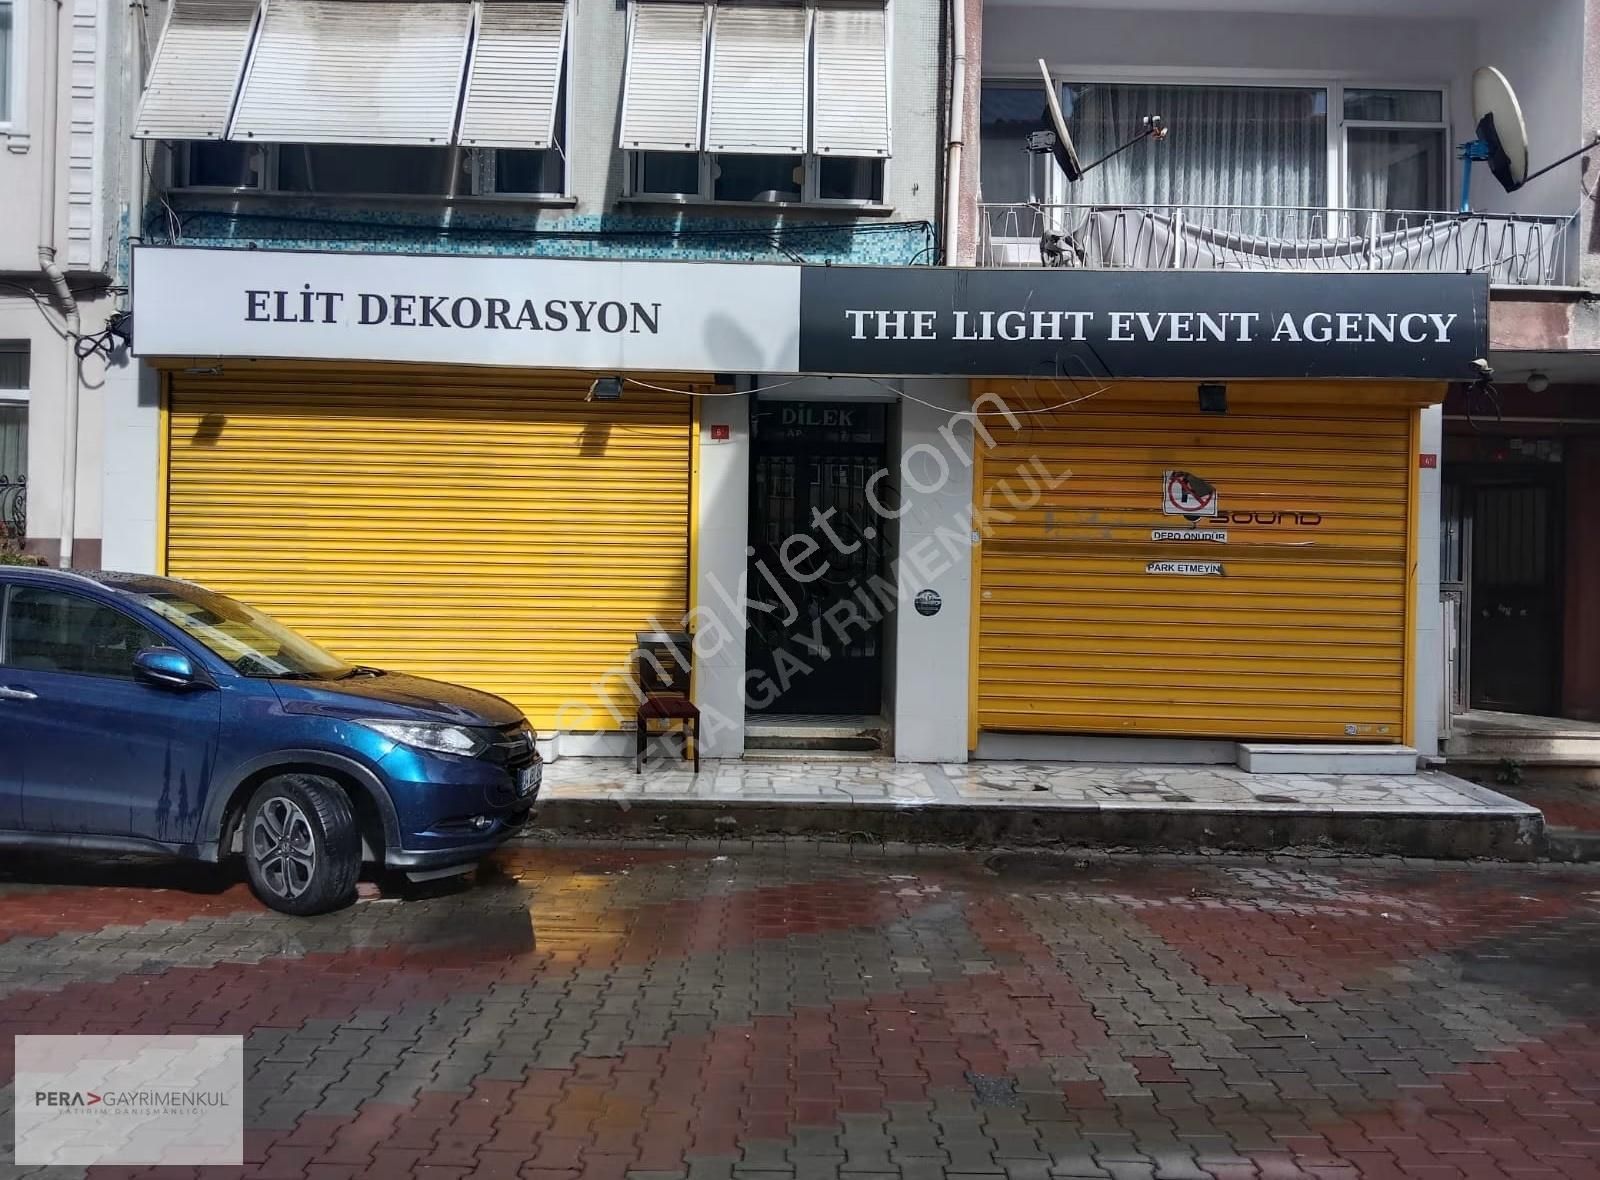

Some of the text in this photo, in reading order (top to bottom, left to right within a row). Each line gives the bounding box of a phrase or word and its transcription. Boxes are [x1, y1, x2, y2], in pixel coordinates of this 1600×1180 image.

[243, 283, 662, 335] ELİT DEKORASYON
[845, 310, 1457, 343] THE LIGHT EVENT AGENCY
[782, 402, 856, 426] DİLEK
[1154, 531, 1181, 540] DEPO
[1147, 563, 1175, 572] PARK
